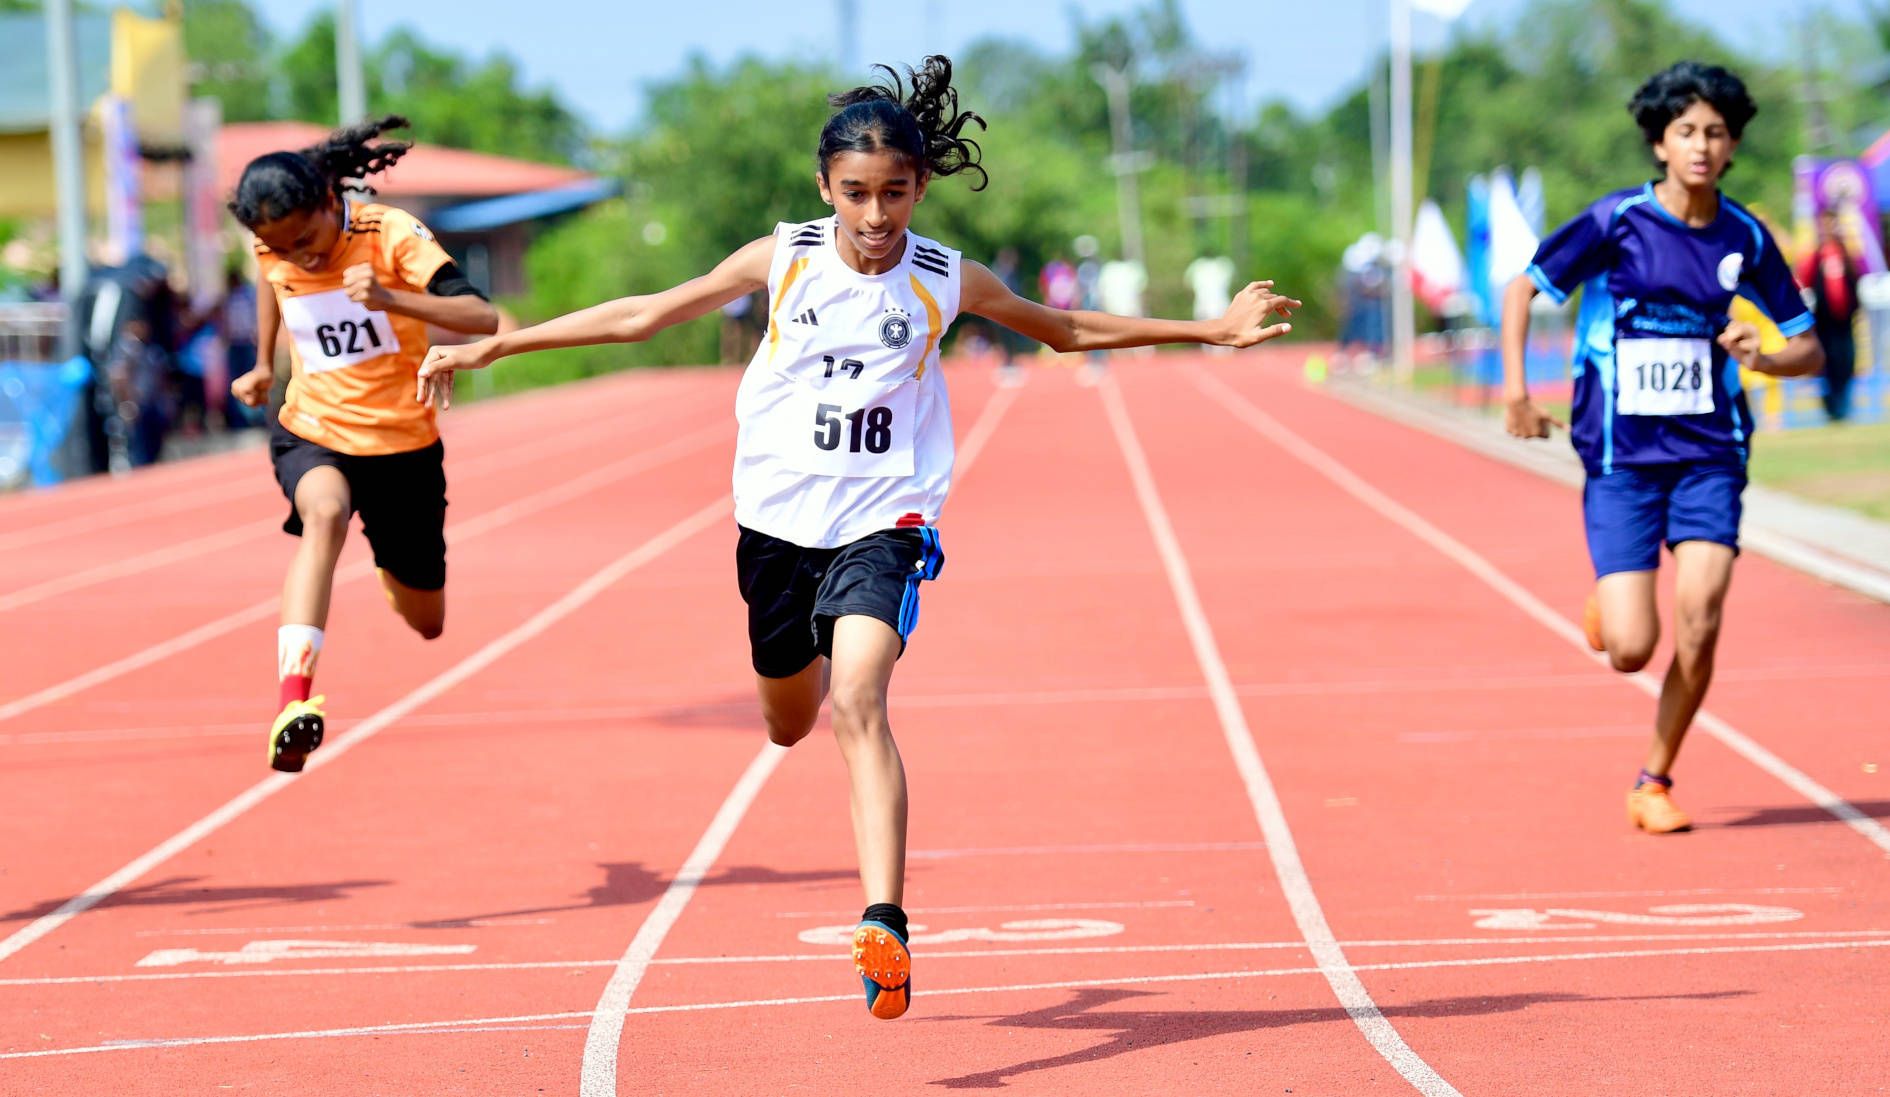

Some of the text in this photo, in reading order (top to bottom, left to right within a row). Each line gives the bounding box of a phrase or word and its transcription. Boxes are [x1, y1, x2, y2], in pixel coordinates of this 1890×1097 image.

[317, 318, 382, 357] 621
[1636, 360, 1703, 392] 1028
[814, 403, 893, 454] 518
